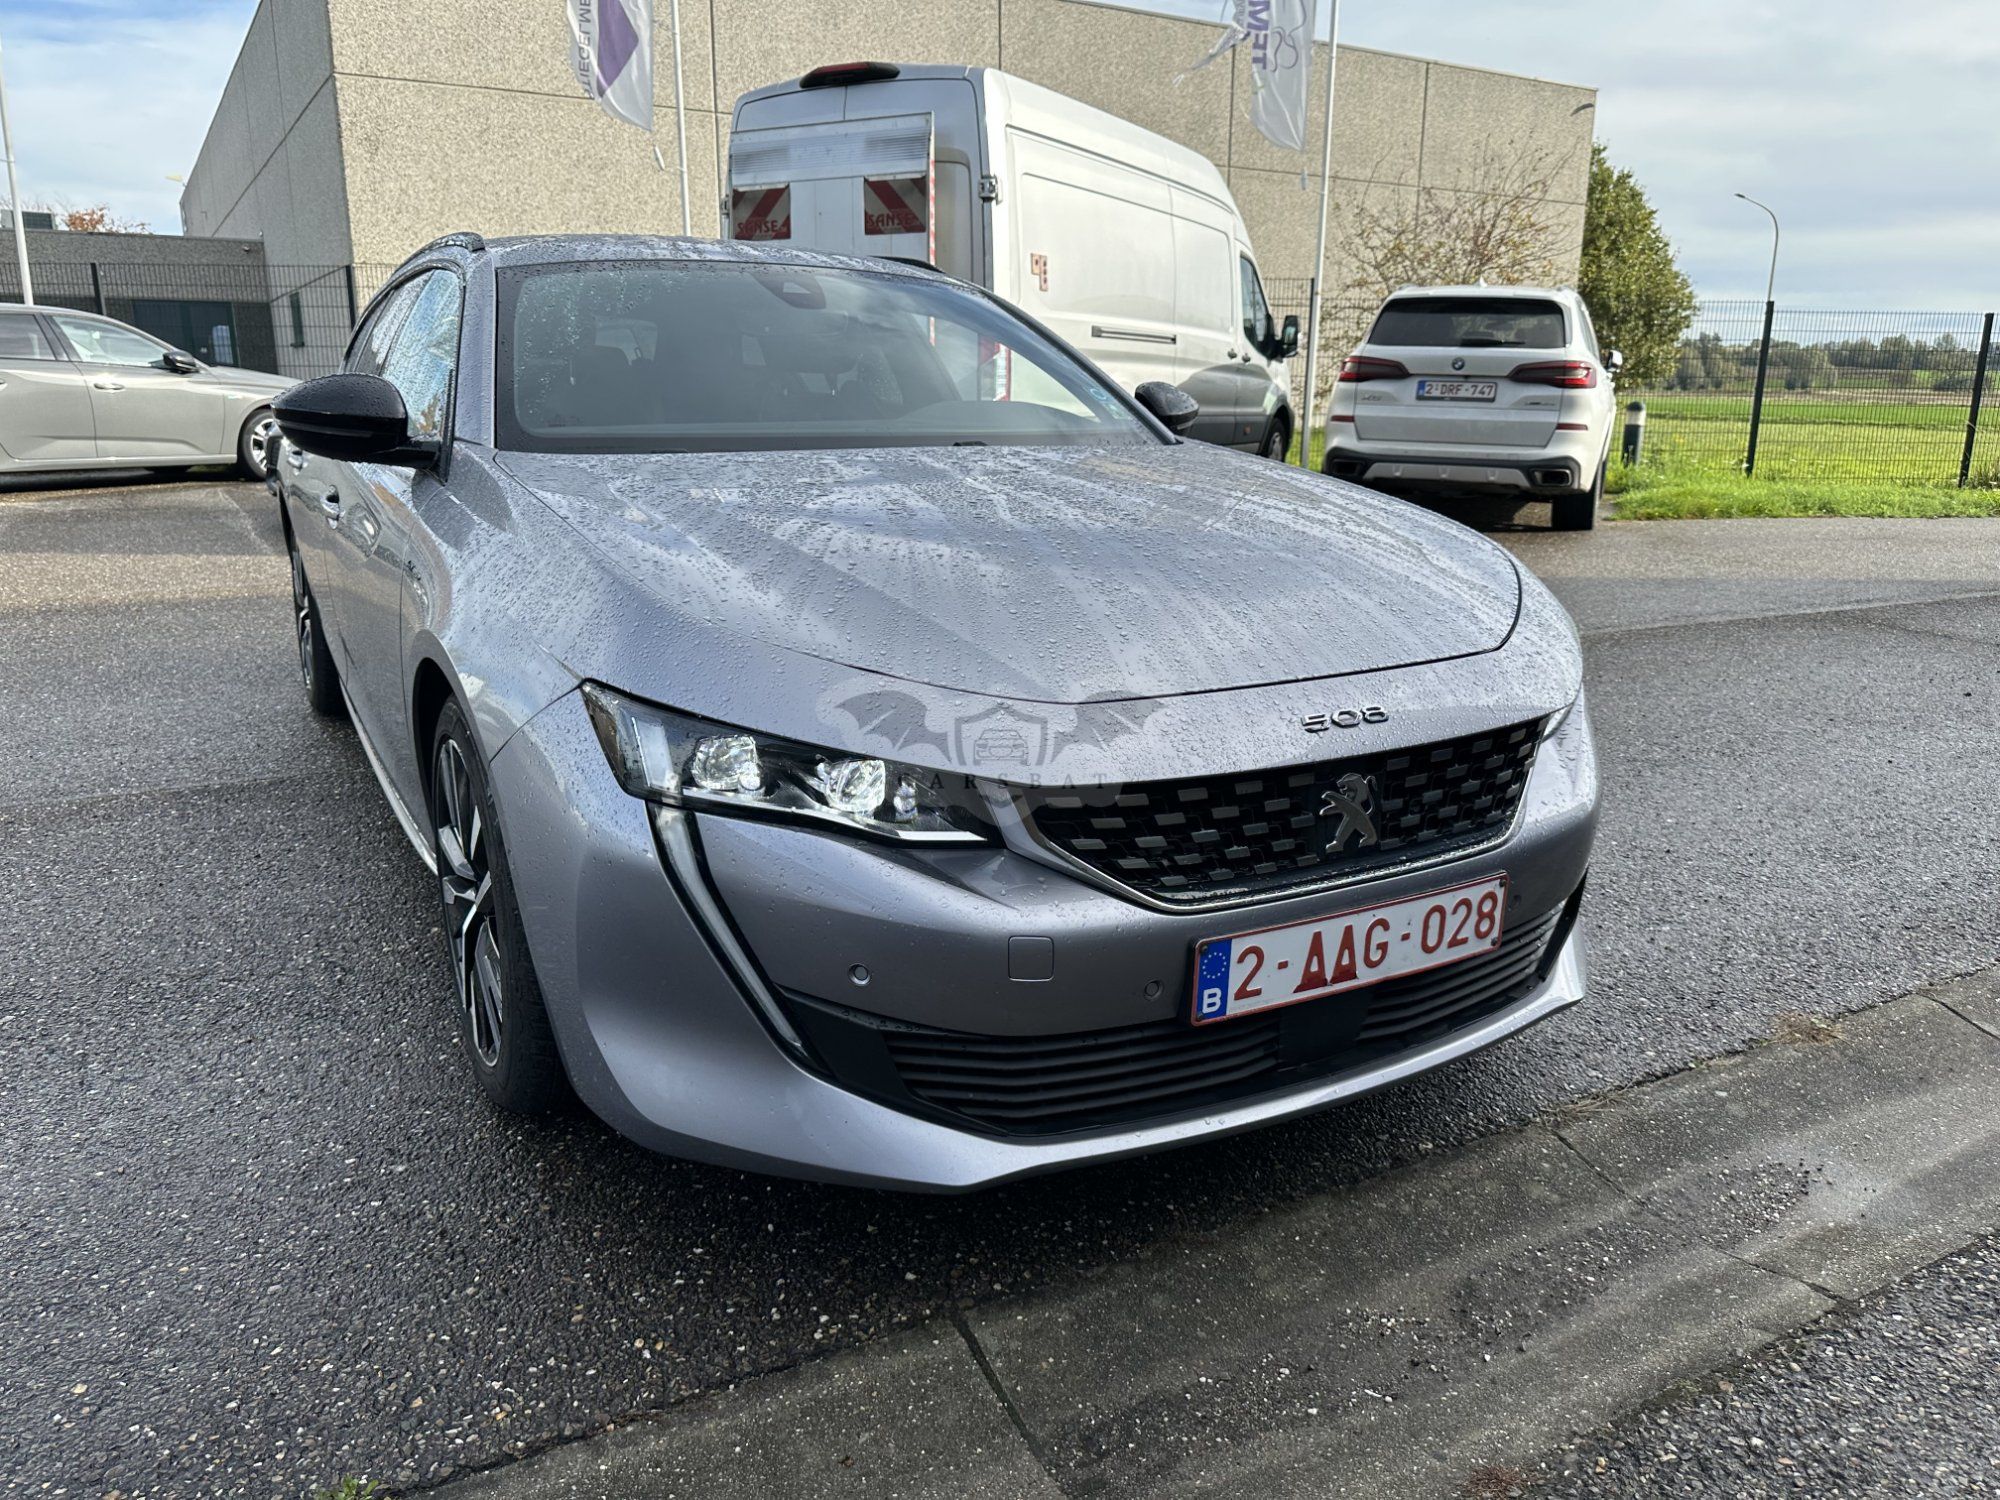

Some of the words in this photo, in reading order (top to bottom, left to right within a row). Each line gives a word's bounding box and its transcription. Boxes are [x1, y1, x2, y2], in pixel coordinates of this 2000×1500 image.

[1301, 705, 1389, 733] 508
[1233, 890, 1499, 1001] 2-AAG-028
[1202, 987, 1222, 1014] B
